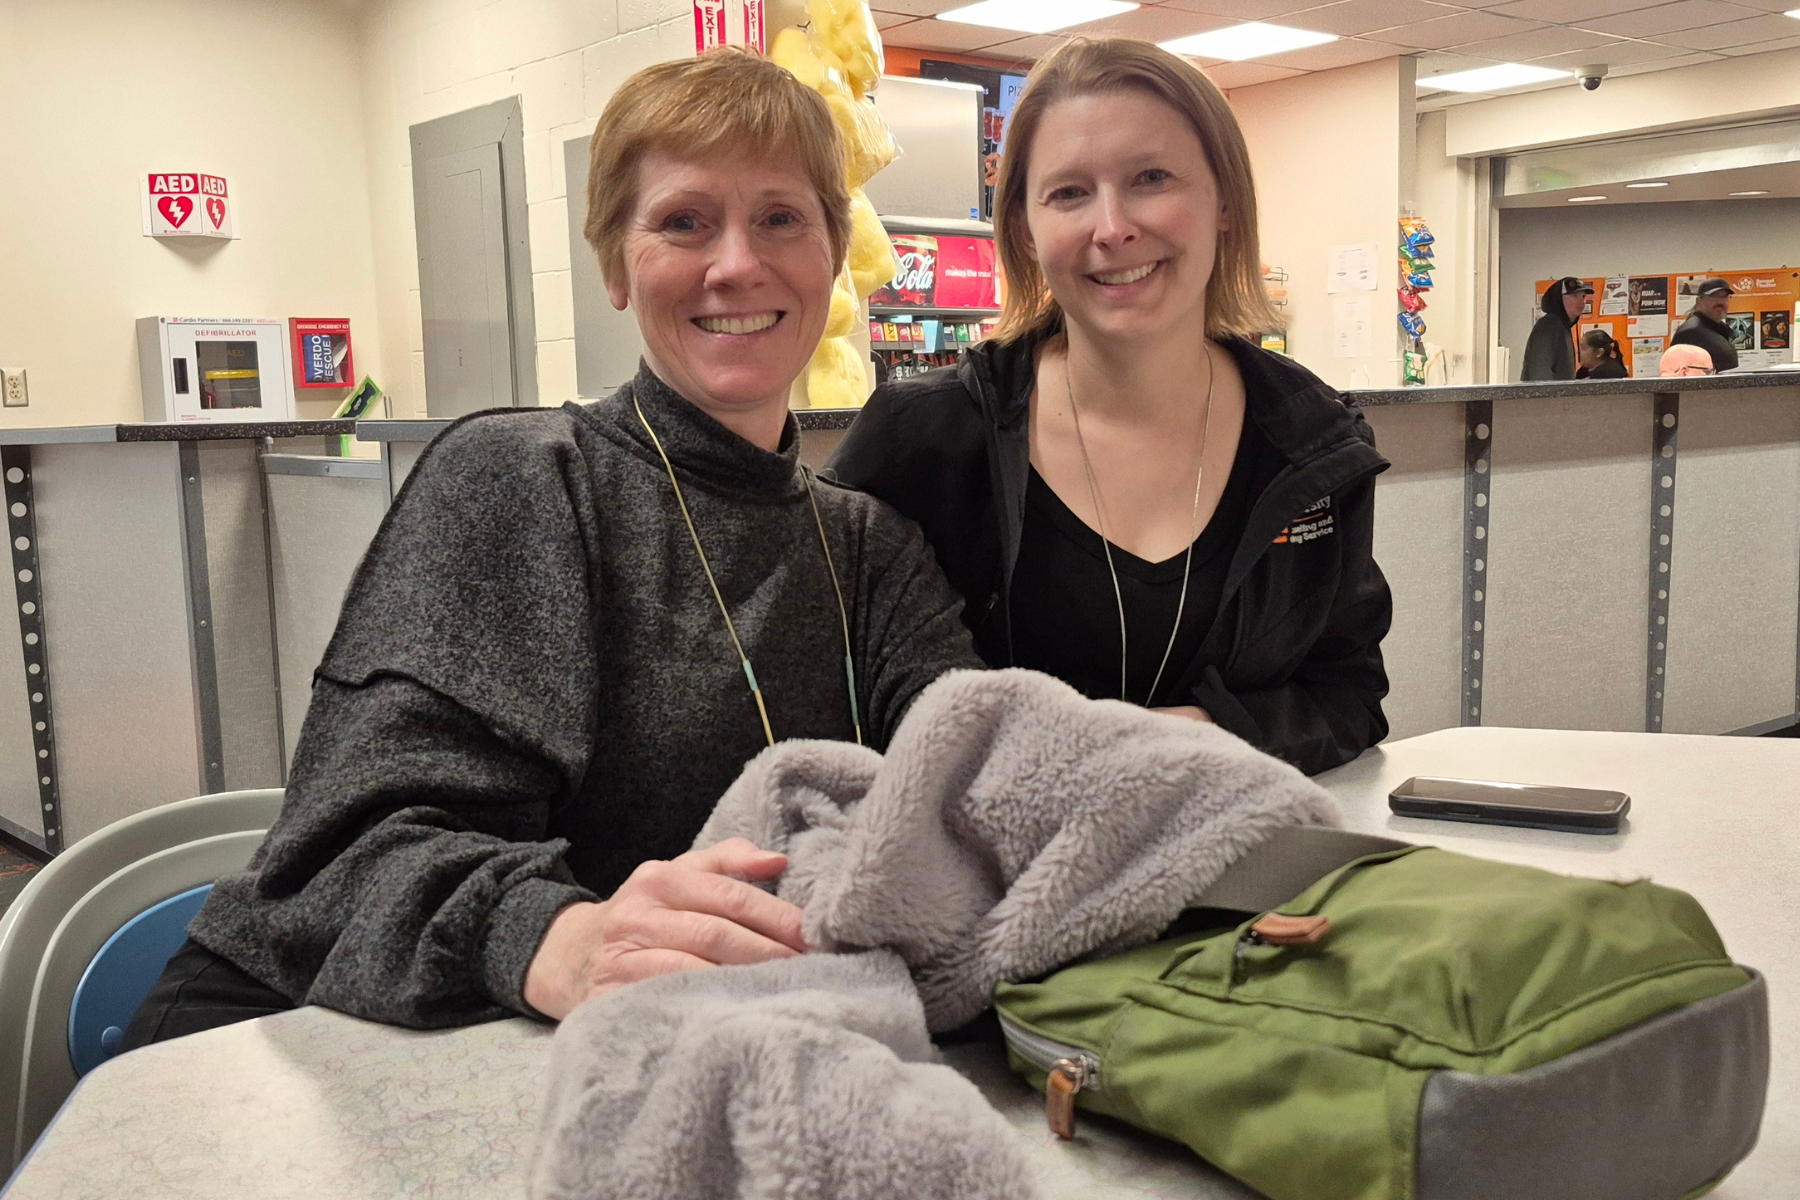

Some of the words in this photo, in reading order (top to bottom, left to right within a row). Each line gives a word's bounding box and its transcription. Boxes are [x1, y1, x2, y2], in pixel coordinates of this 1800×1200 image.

[153, 175, 195, 192] AED
[203, 176, 226, 195] AED
[892, 252, 935, 290] Cola
[945, 268, 965, 278] makes
[967, 268, 977, 277] the
[1317, 515, 1334, 527] and
[1303, 527, 1333, 541] Service
